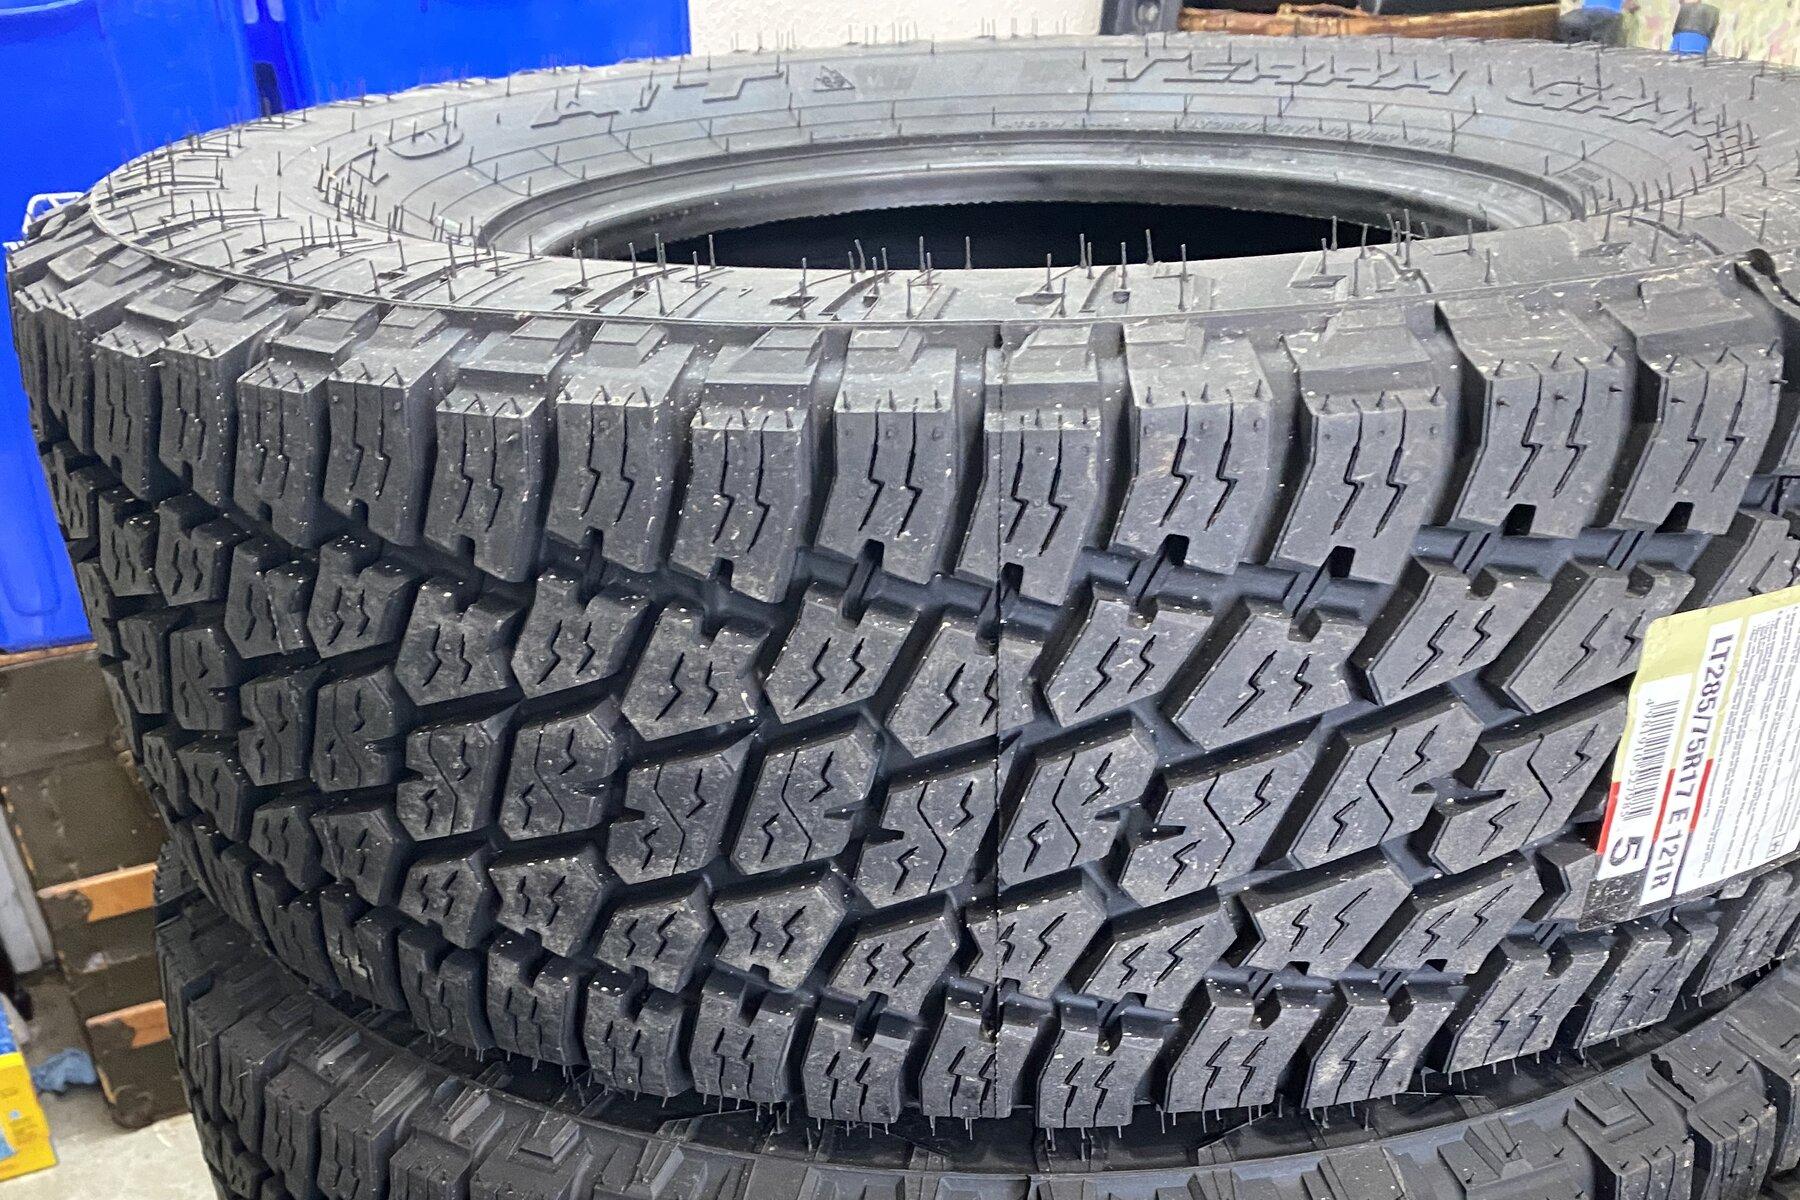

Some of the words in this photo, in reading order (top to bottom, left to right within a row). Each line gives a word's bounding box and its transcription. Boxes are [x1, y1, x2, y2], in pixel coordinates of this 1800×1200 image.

[1675, 634, 1734, 797] LT285/75R17
[1667, 807, 1689, 825] E
[1610, 836, 1645, 866] 5
[1651, 831, 1683, 890] 121R
